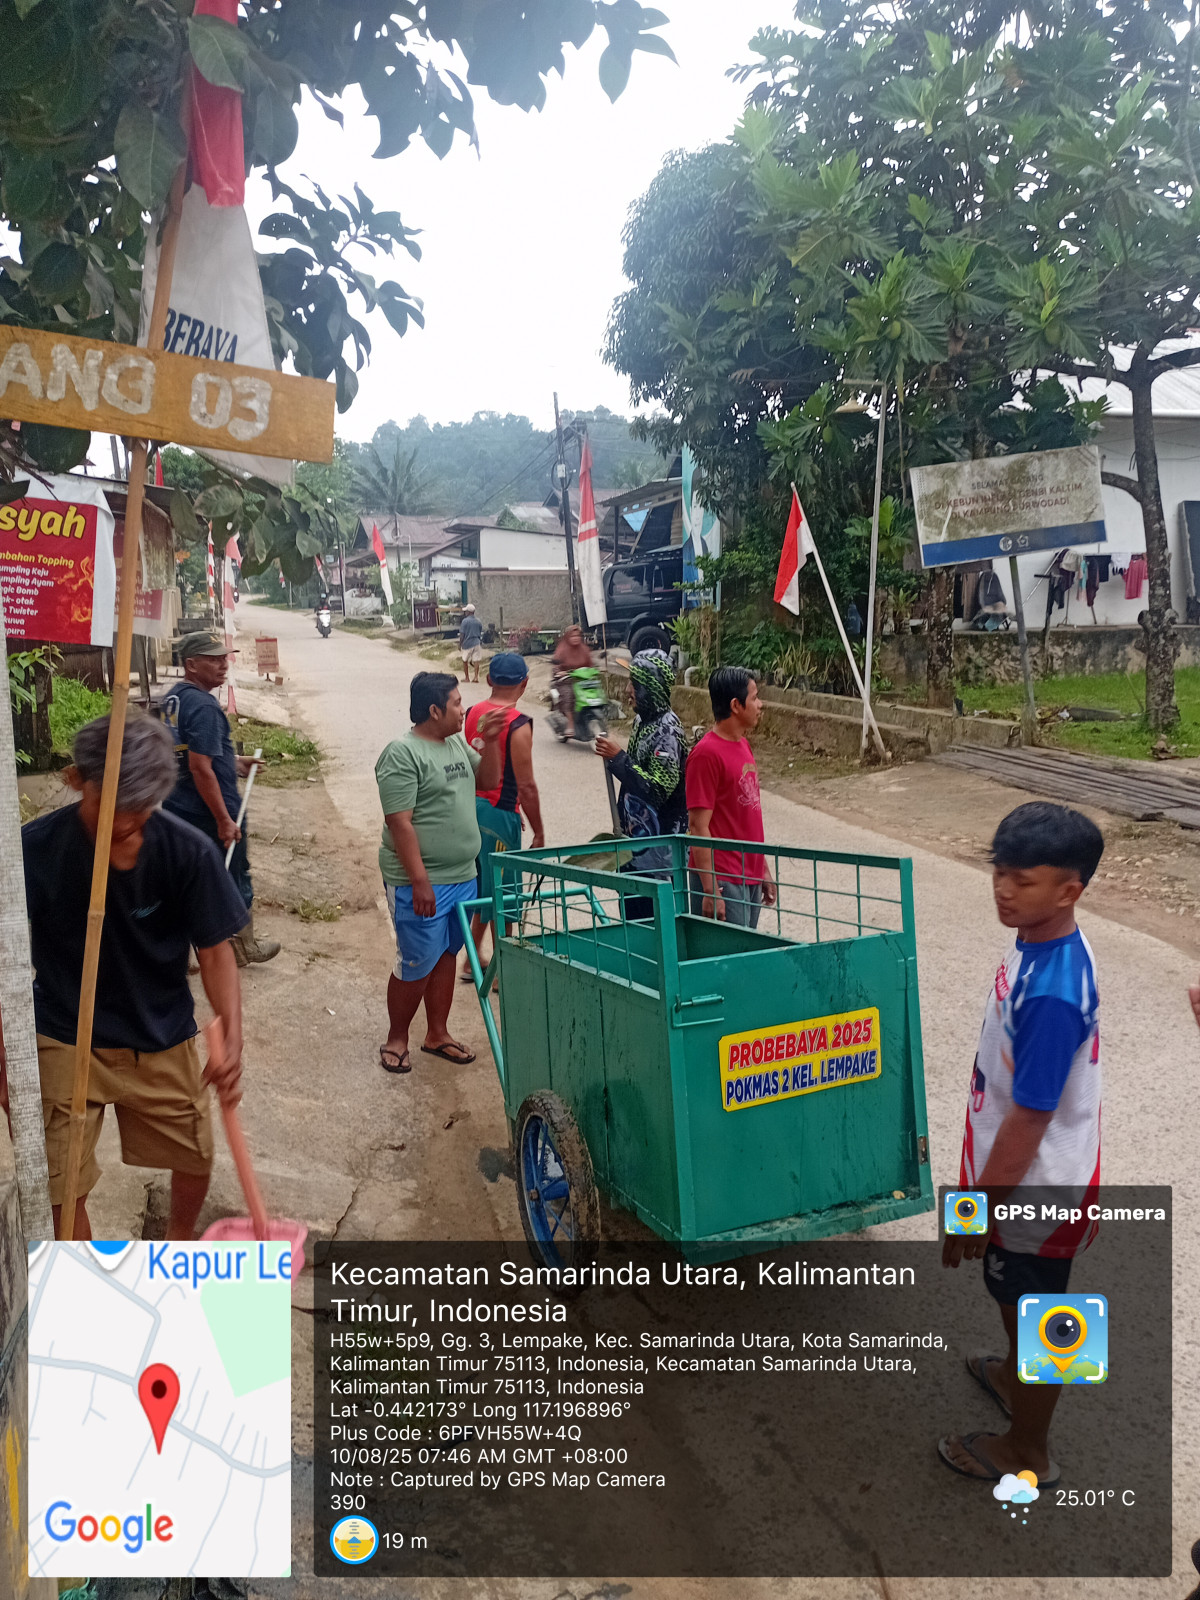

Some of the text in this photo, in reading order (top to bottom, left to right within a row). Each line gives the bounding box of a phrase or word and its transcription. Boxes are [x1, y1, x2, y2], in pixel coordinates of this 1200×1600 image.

[0, 342, 273, 441] ANG 03
[971, 478, 1009, 491] SELAMAT
[934, 501, 944, 509] DI
[946, 496, 979, 508] KEBUN
[1049, 482, 1083, 494] KALTIM
[951, 497, 1070, 519] DI KAMPUNG PURWODADI
[0, 505, 86, 541] syah
[37, 554, 74, 569] Topping
[32, 567, 49, 577] Keju
[31, 577, 54, 587] Ayam
[16, 585, 39, 596] Bomb
[15, 596, 35, 606] otak
[9, 606, 39, 616] Twister
[728, 1017, 873, 1071] PROBEBAYA 2025
[725, 1050, 878, 1106] POKMAS 2 KEL. LEMPAKE
